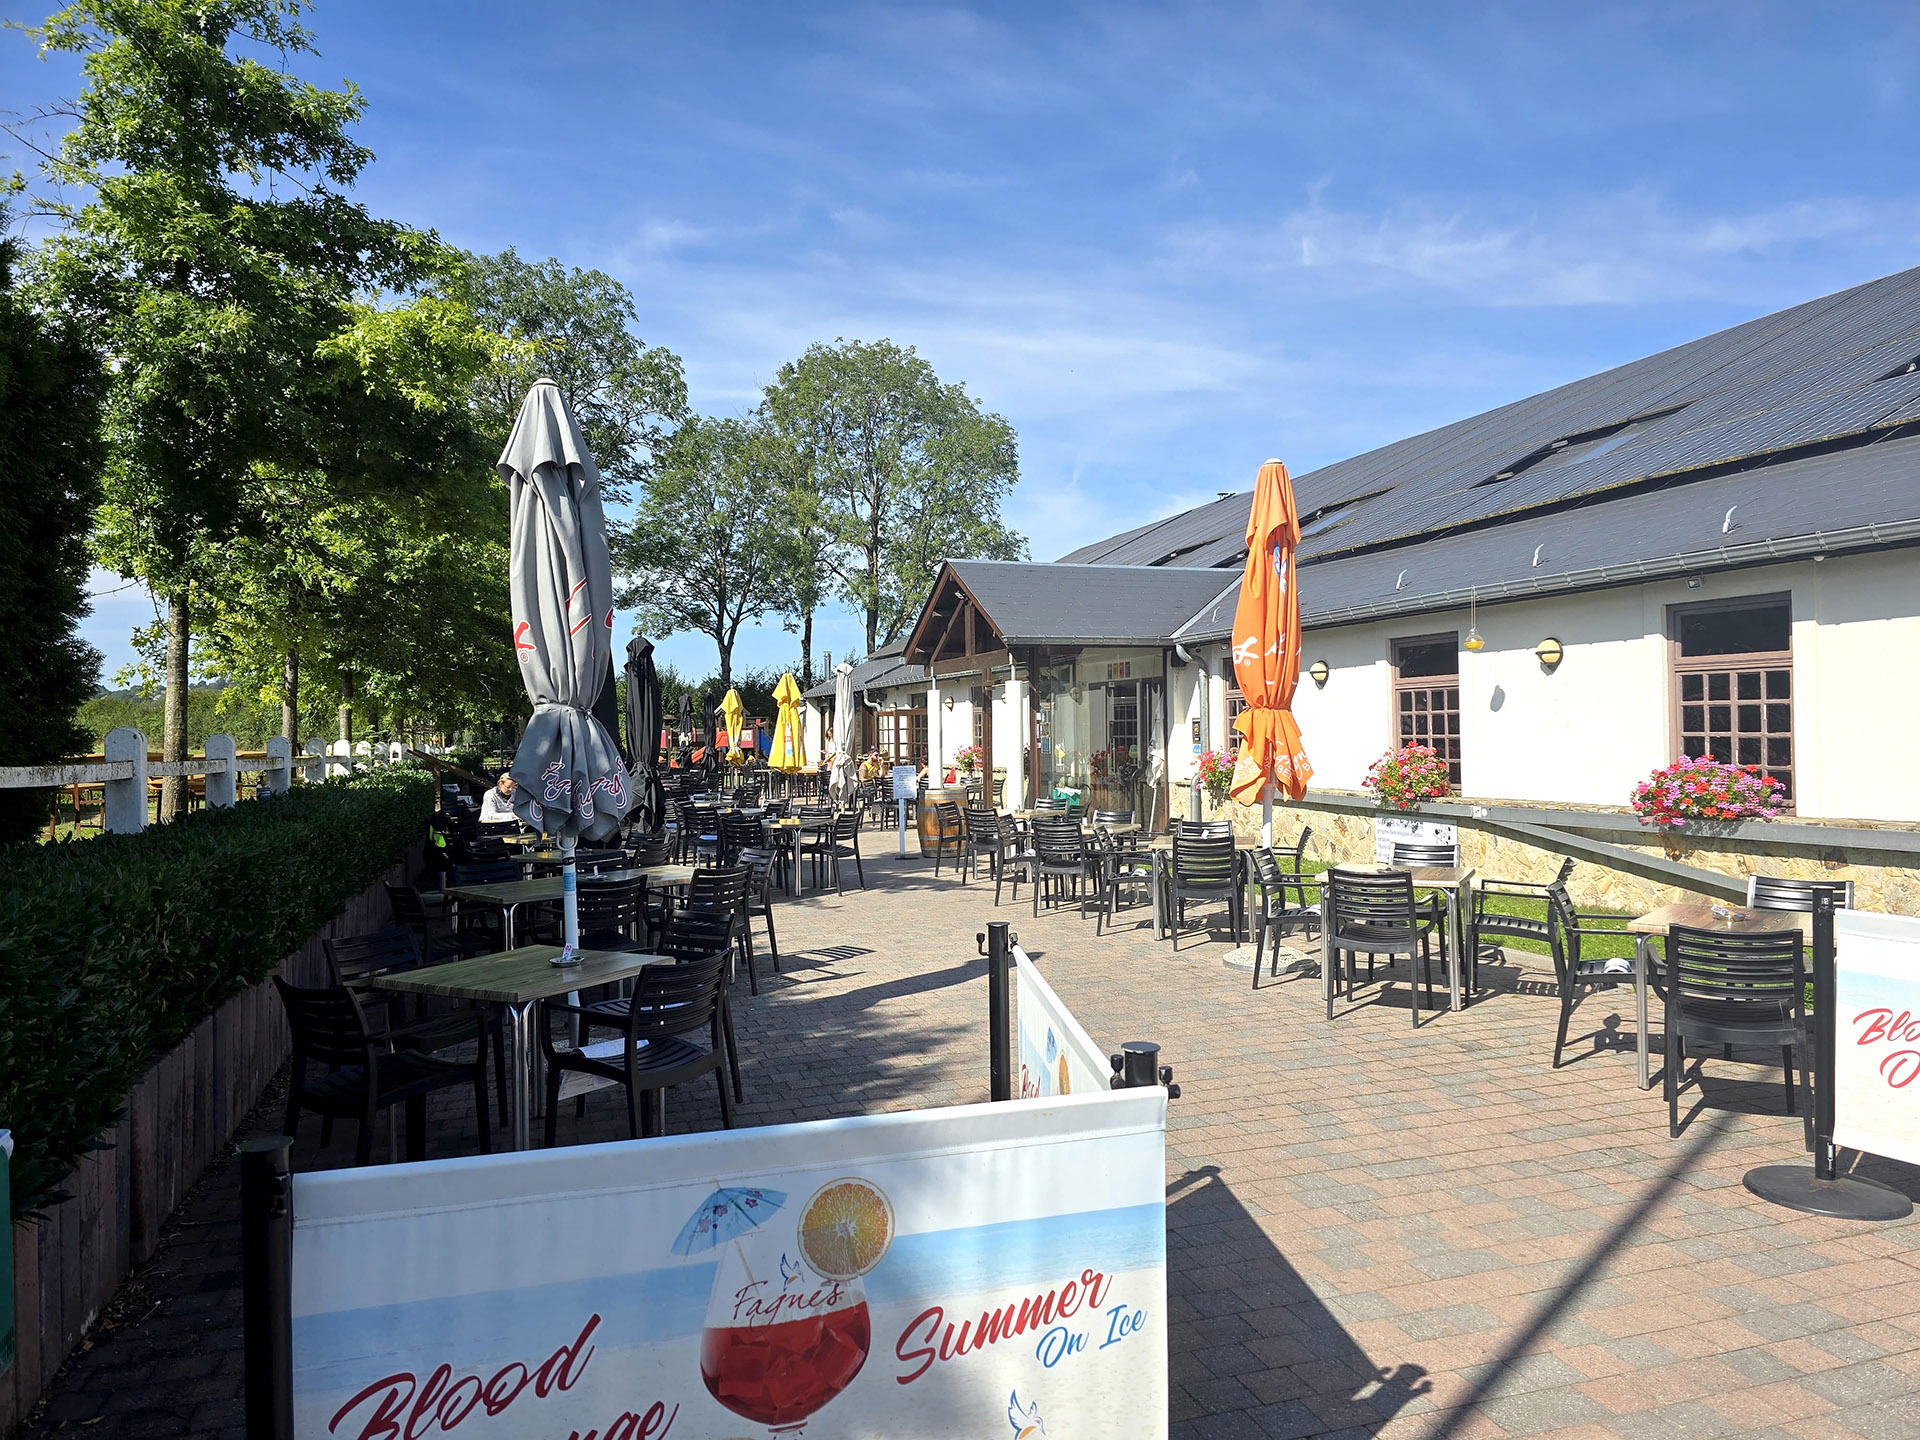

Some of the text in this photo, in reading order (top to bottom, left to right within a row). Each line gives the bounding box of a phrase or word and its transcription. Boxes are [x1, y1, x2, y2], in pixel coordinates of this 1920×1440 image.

[1852, 1008, 1920, 1046] Blo
[733, 1280, 845, 1332] Fagnes
[896, 1269, 1113, 1385] Summer
[1036, 1304, 1148, 1369] On Ice
[328, 1312, 602, 1440] Blood
